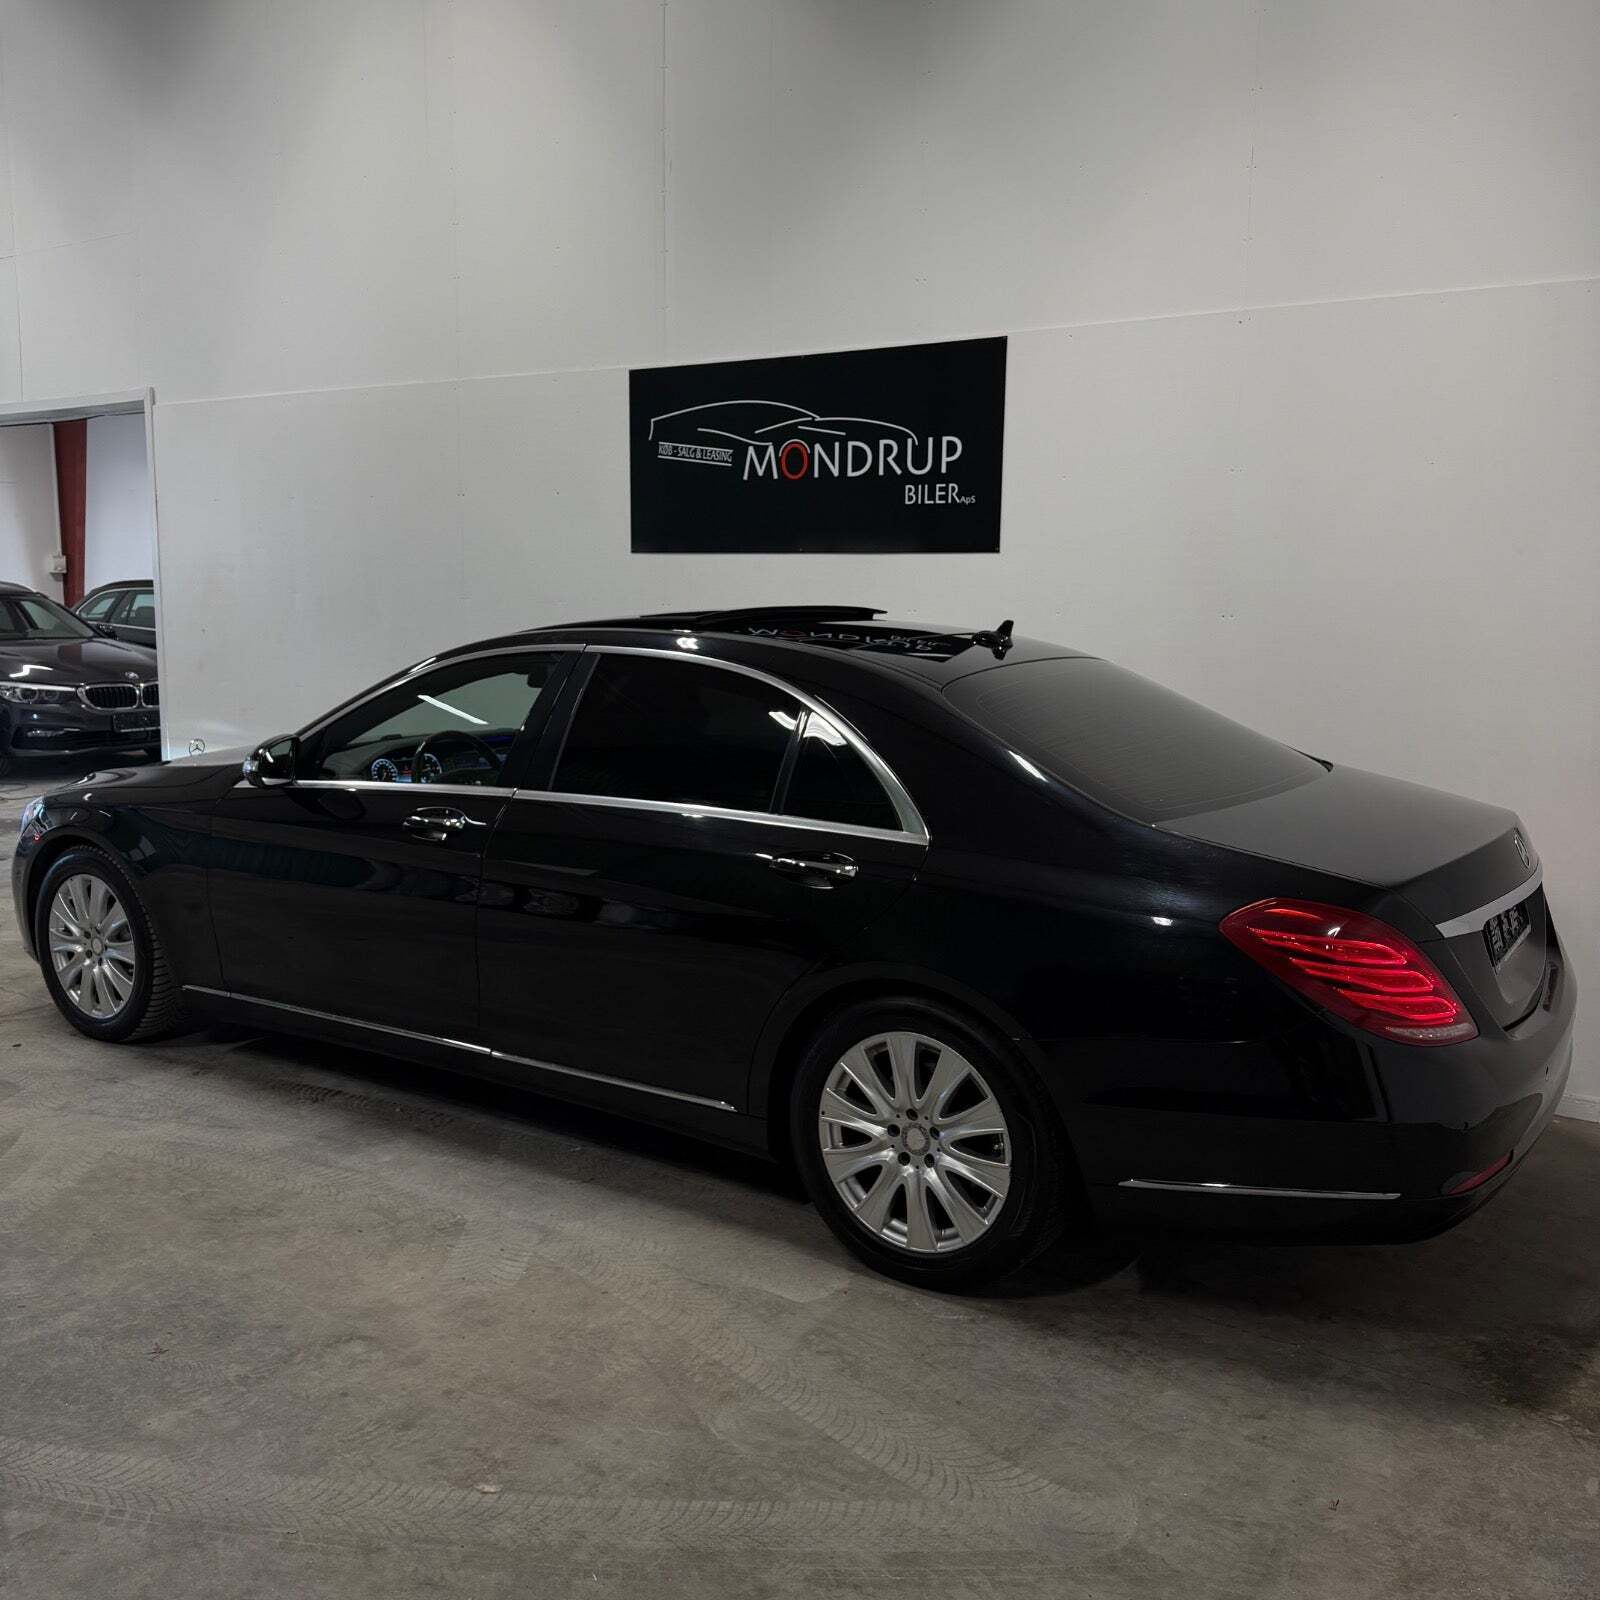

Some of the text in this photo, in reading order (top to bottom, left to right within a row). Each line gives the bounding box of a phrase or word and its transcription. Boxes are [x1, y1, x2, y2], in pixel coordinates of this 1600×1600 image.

[678, 446, 695, 458] SALG
[703, 449, 733, 462] LEASING
[743, 436, 963, 480] MONDRUP
[905, 483, 960, 505] BILER
